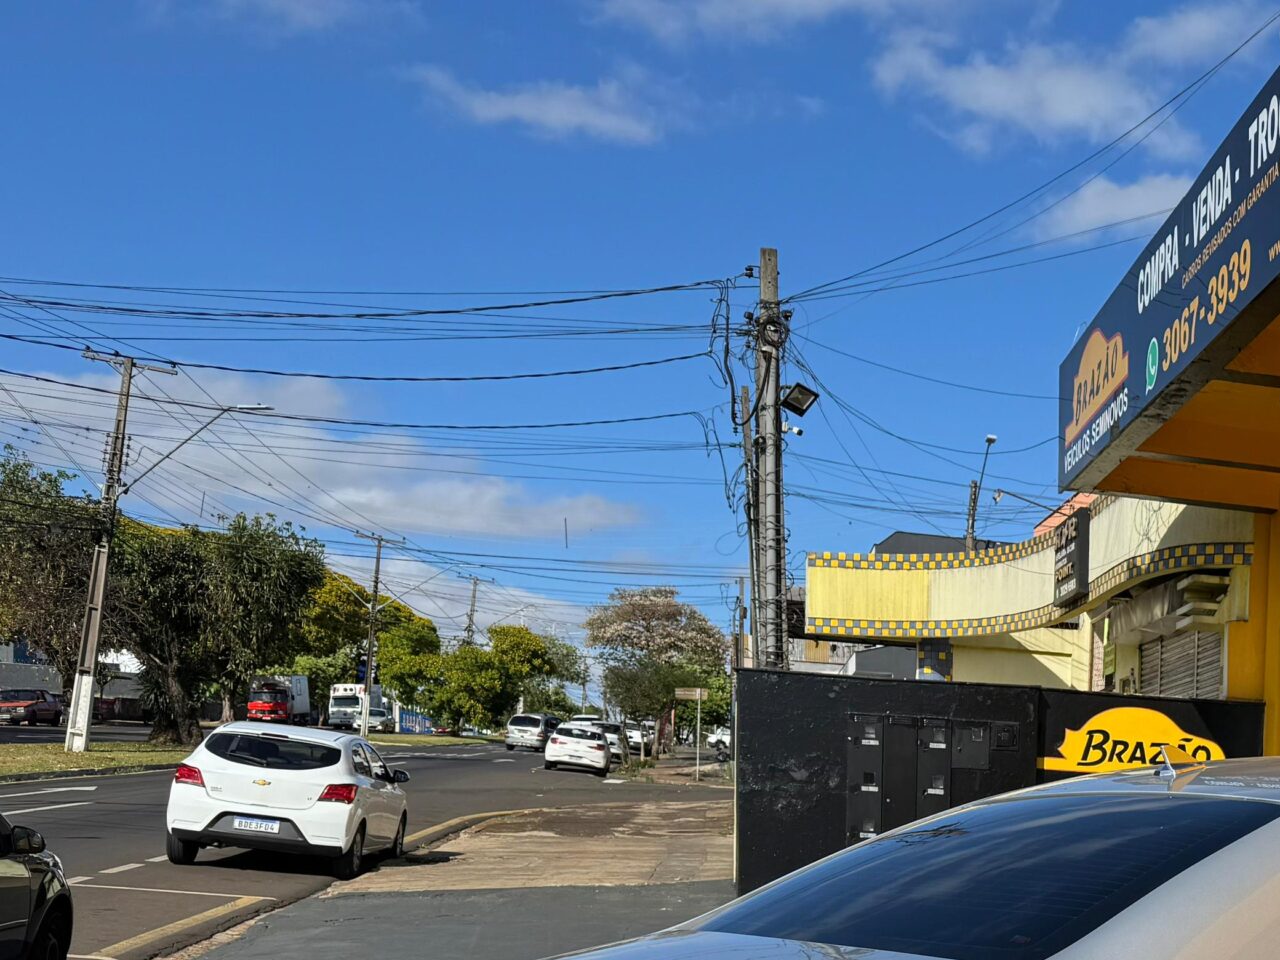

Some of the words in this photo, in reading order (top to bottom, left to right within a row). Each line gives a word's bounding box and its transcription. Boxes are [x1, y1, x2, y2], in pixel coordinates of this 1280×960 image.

[1137, 225, 1179, 314] COMPRA
[1192, 154, 1232, 249] VENDA
[1181, 254, 1202, 289] CARROS
[1202, 217, 1233, 265] REVISADOS
[1232, 198, 1247, 228] COM
[1246, 161, 1280, 210] GARANTIA
[1162, 238, 1251, 372] 3067-3939
[1064, 429, 1091, 474] VEÍCULOS
[1091, 386, 1129, 447] SEMINOVOS
[1075, 341, 1118, 427] BRAZÃO
